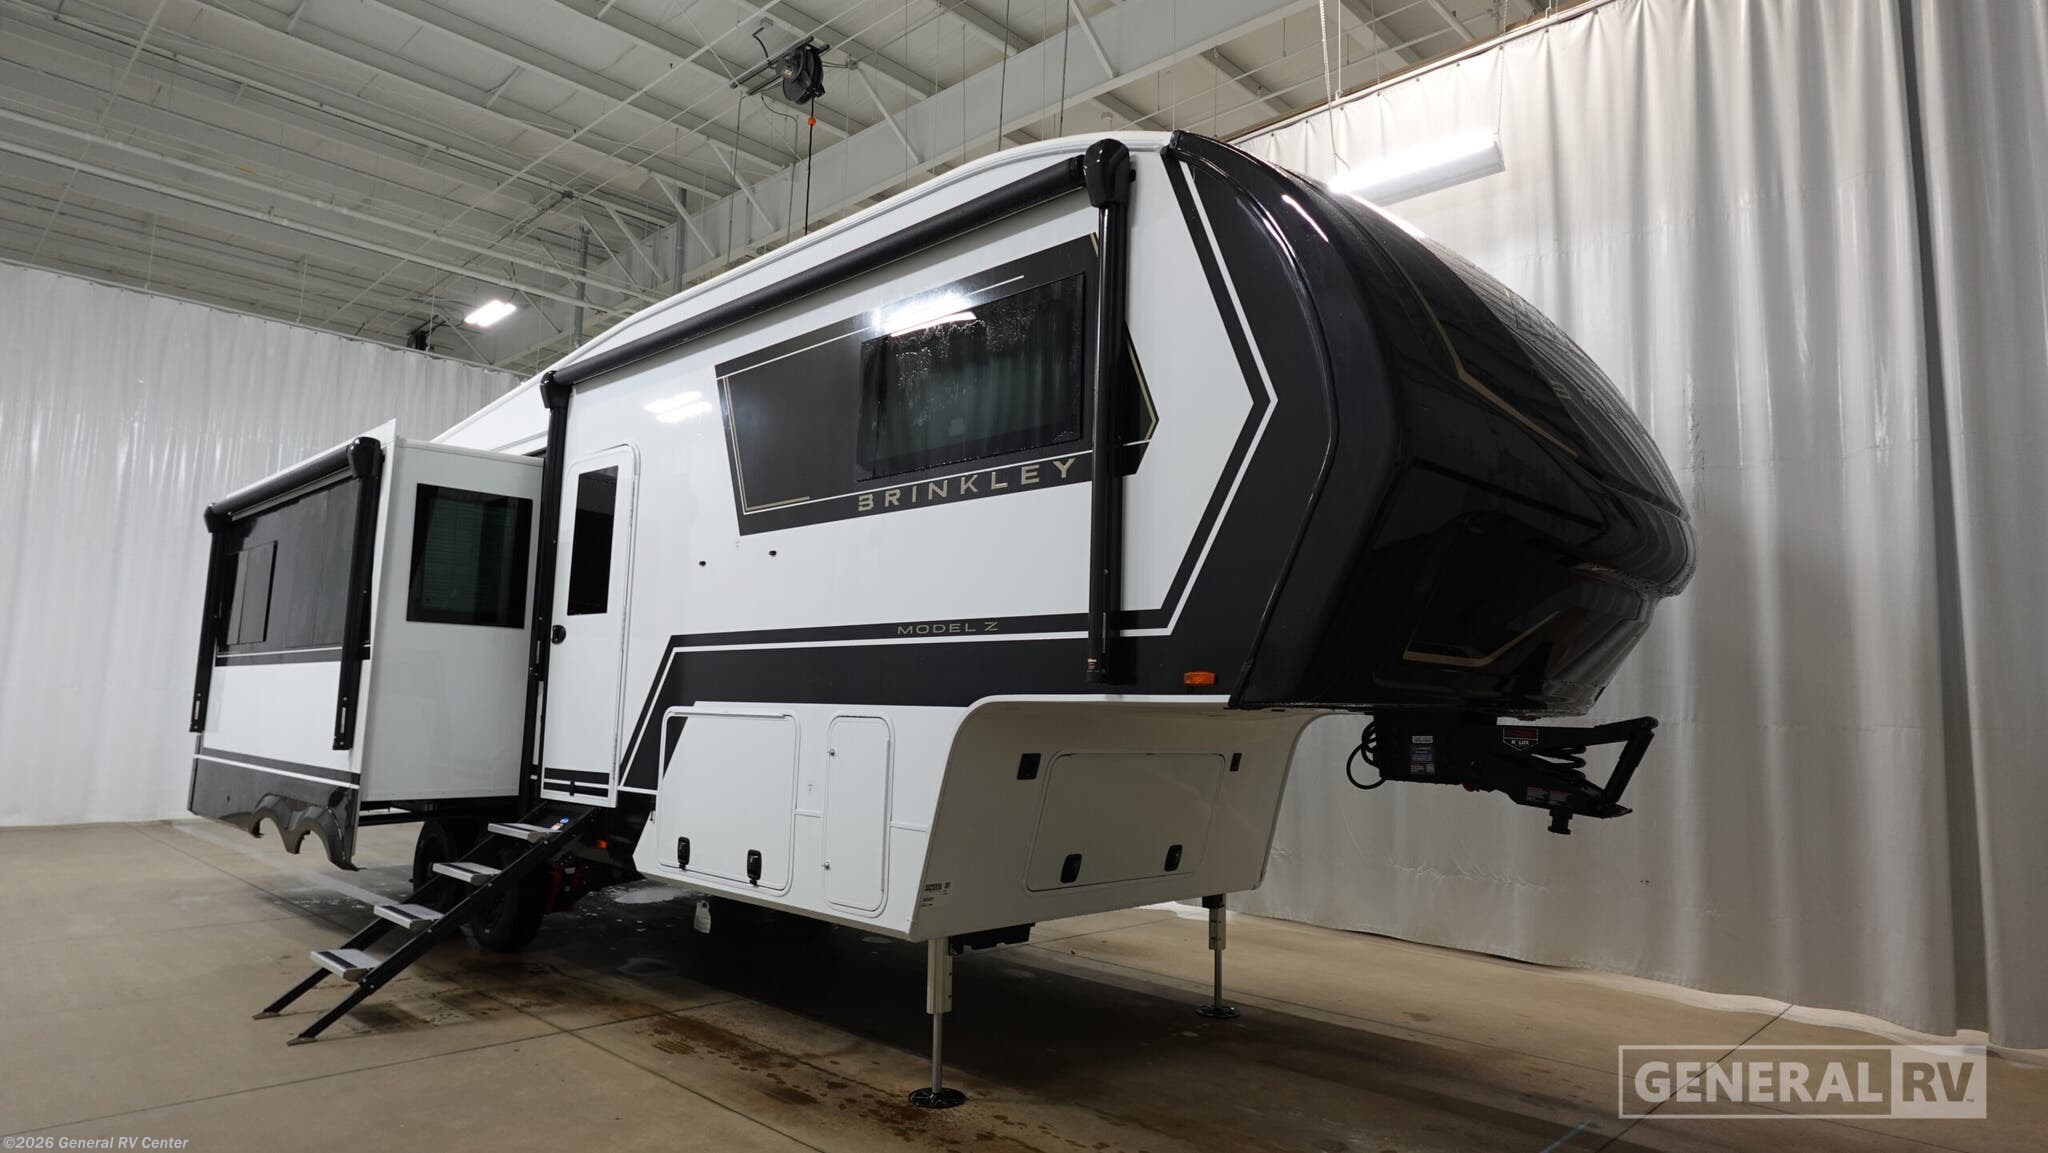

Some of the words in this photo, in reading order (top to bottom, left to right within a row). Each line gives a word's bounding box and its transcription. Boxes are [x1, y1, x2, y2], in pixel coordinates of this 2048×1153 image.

[858, 458, 1076, 512] BRINKLEY
[897, 622, 977, 635] MODEL
[983, 621, 1000, 633] Z
